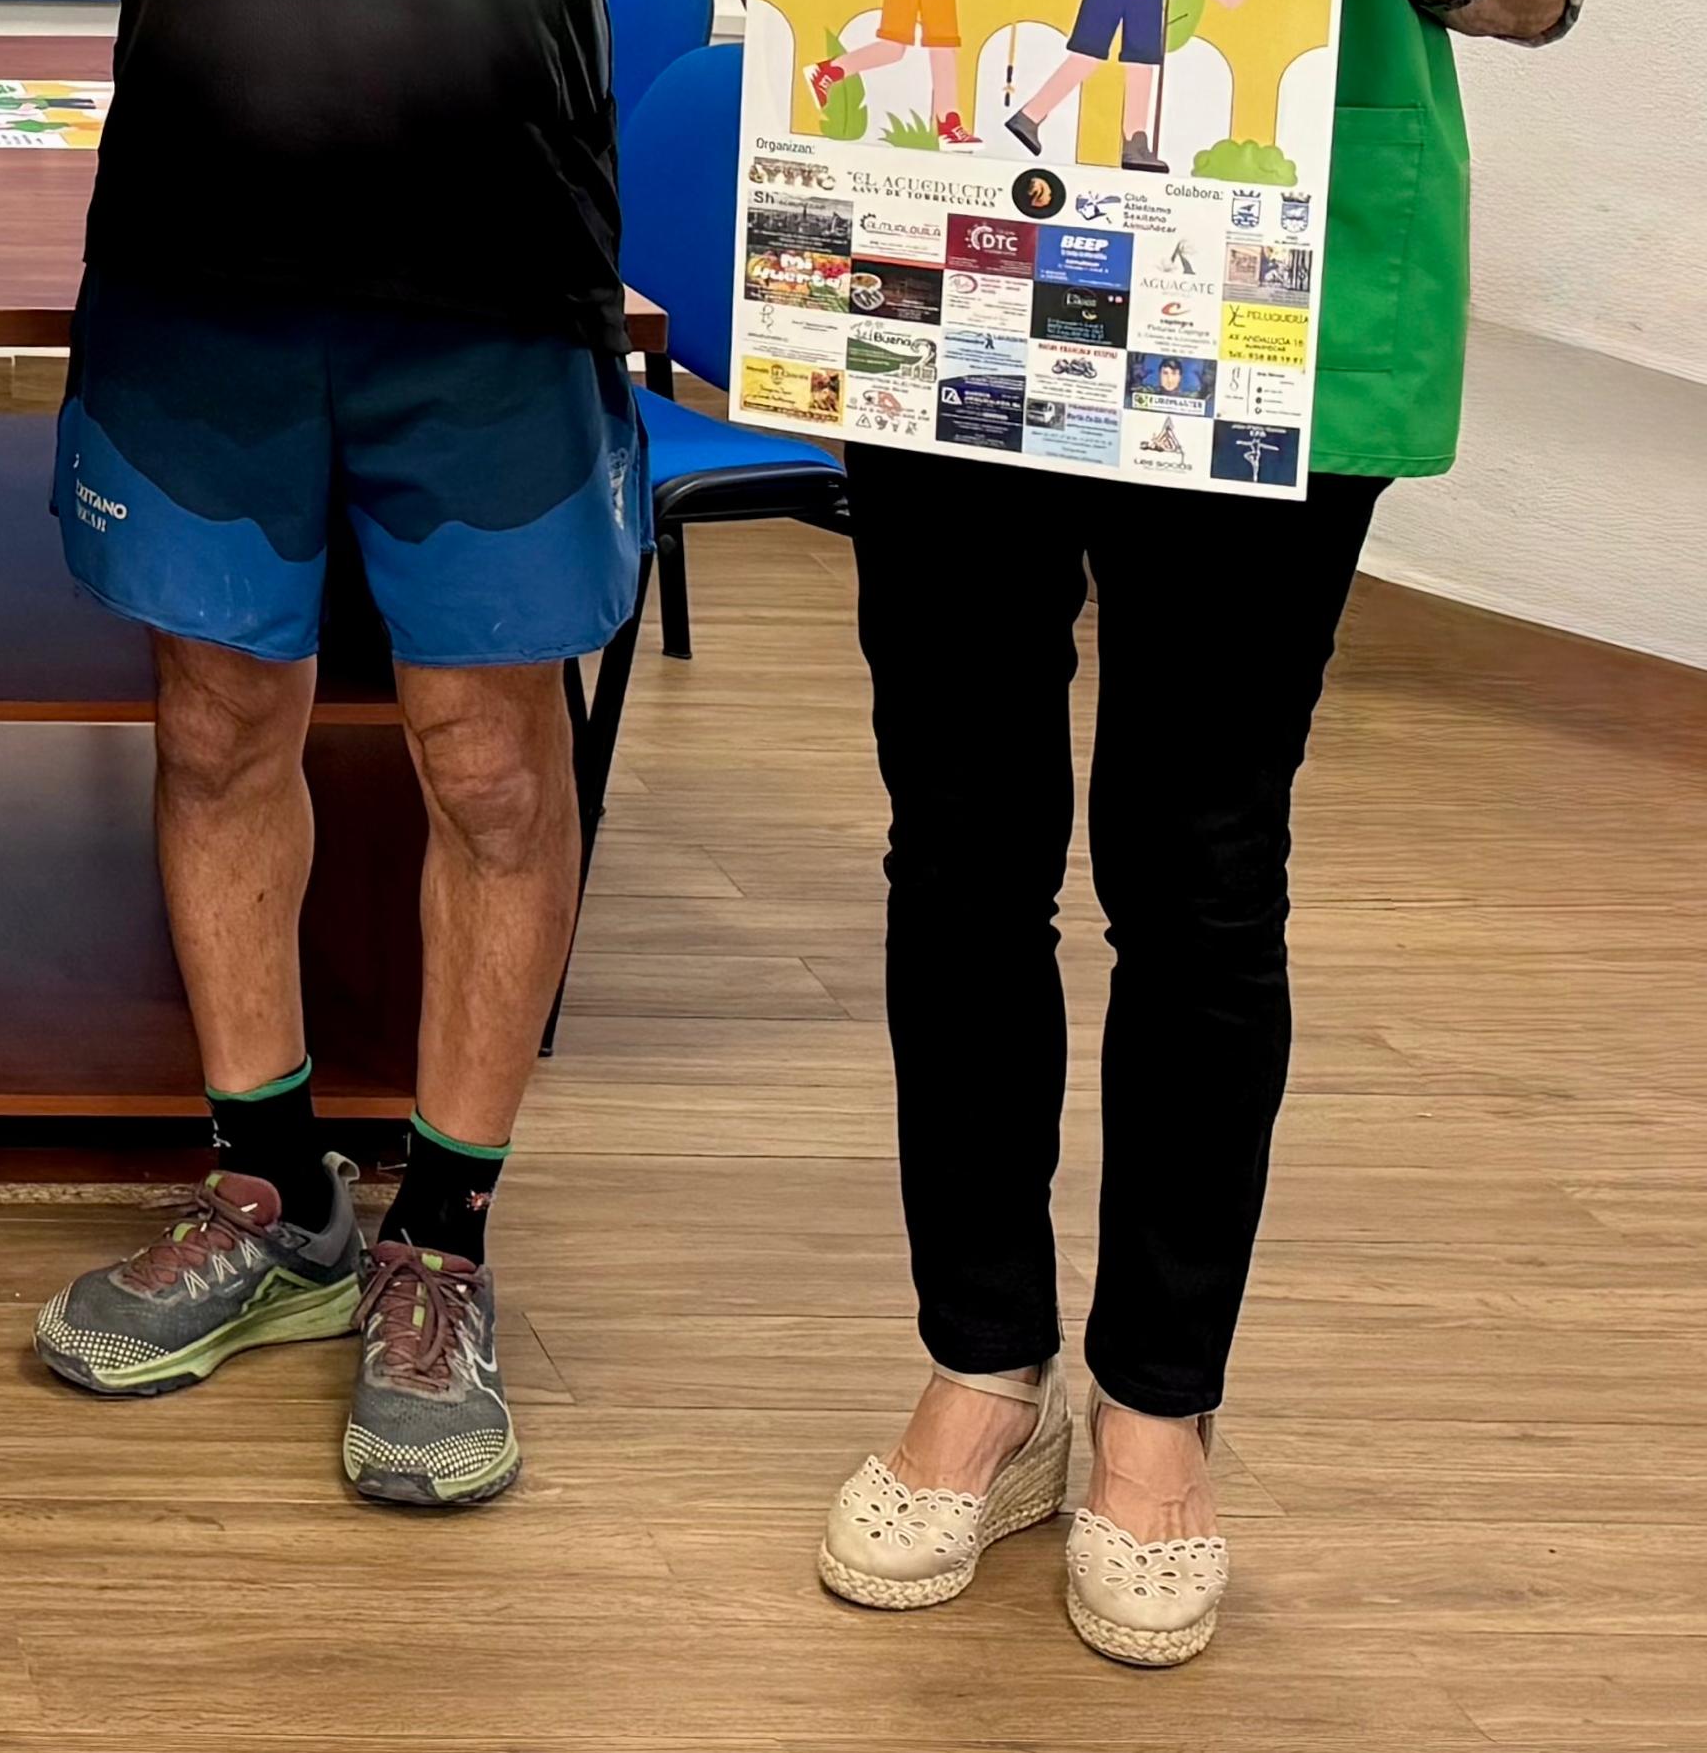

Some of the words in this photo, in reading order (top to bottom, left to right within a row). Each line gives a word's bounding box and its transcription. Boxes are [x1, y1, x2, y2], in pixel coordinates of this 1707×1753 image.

[756, 138, 815, 155] Organizan:
[1165, 184, 1223, 201] Colabora:
[982, 233, 1018, 251] DTC
[1061, 235, 1109, 251] BEEP
